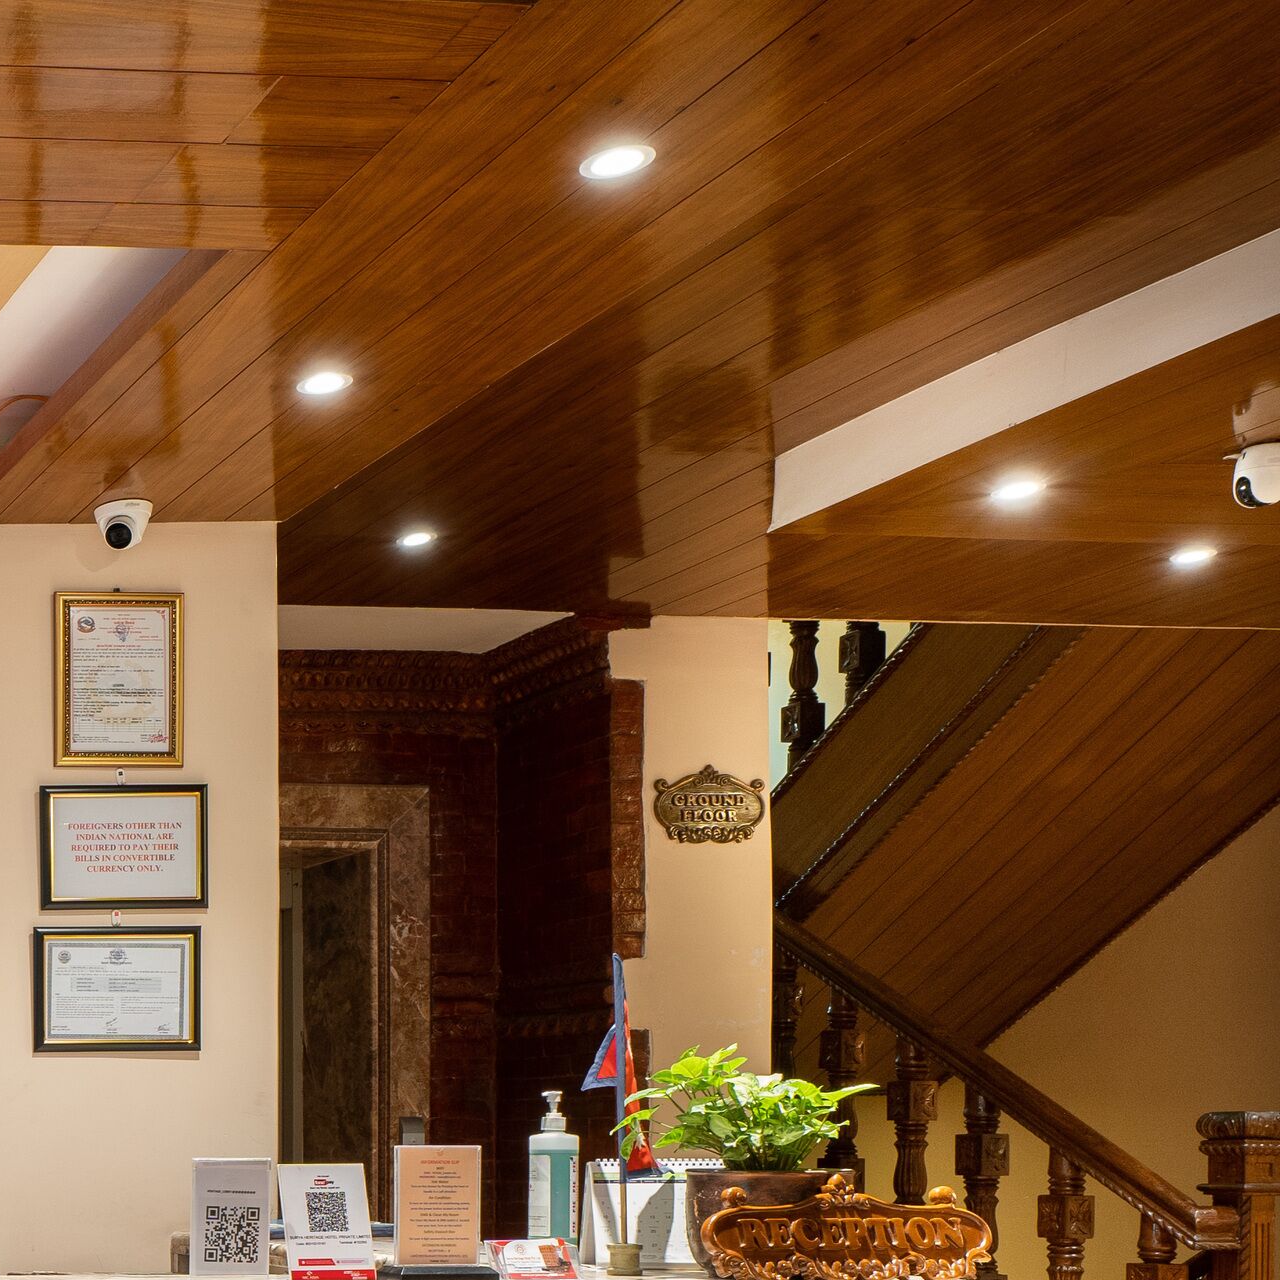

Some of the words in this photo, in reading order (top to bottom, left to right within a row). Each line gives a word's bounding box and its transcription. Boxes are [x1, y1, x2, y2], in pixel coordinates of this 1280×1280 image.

[671, 793, 746, 806] GROUND
[680, 808, 738, 822] FLOOR
[737, 1217, 966, 1250] RECEPTION
